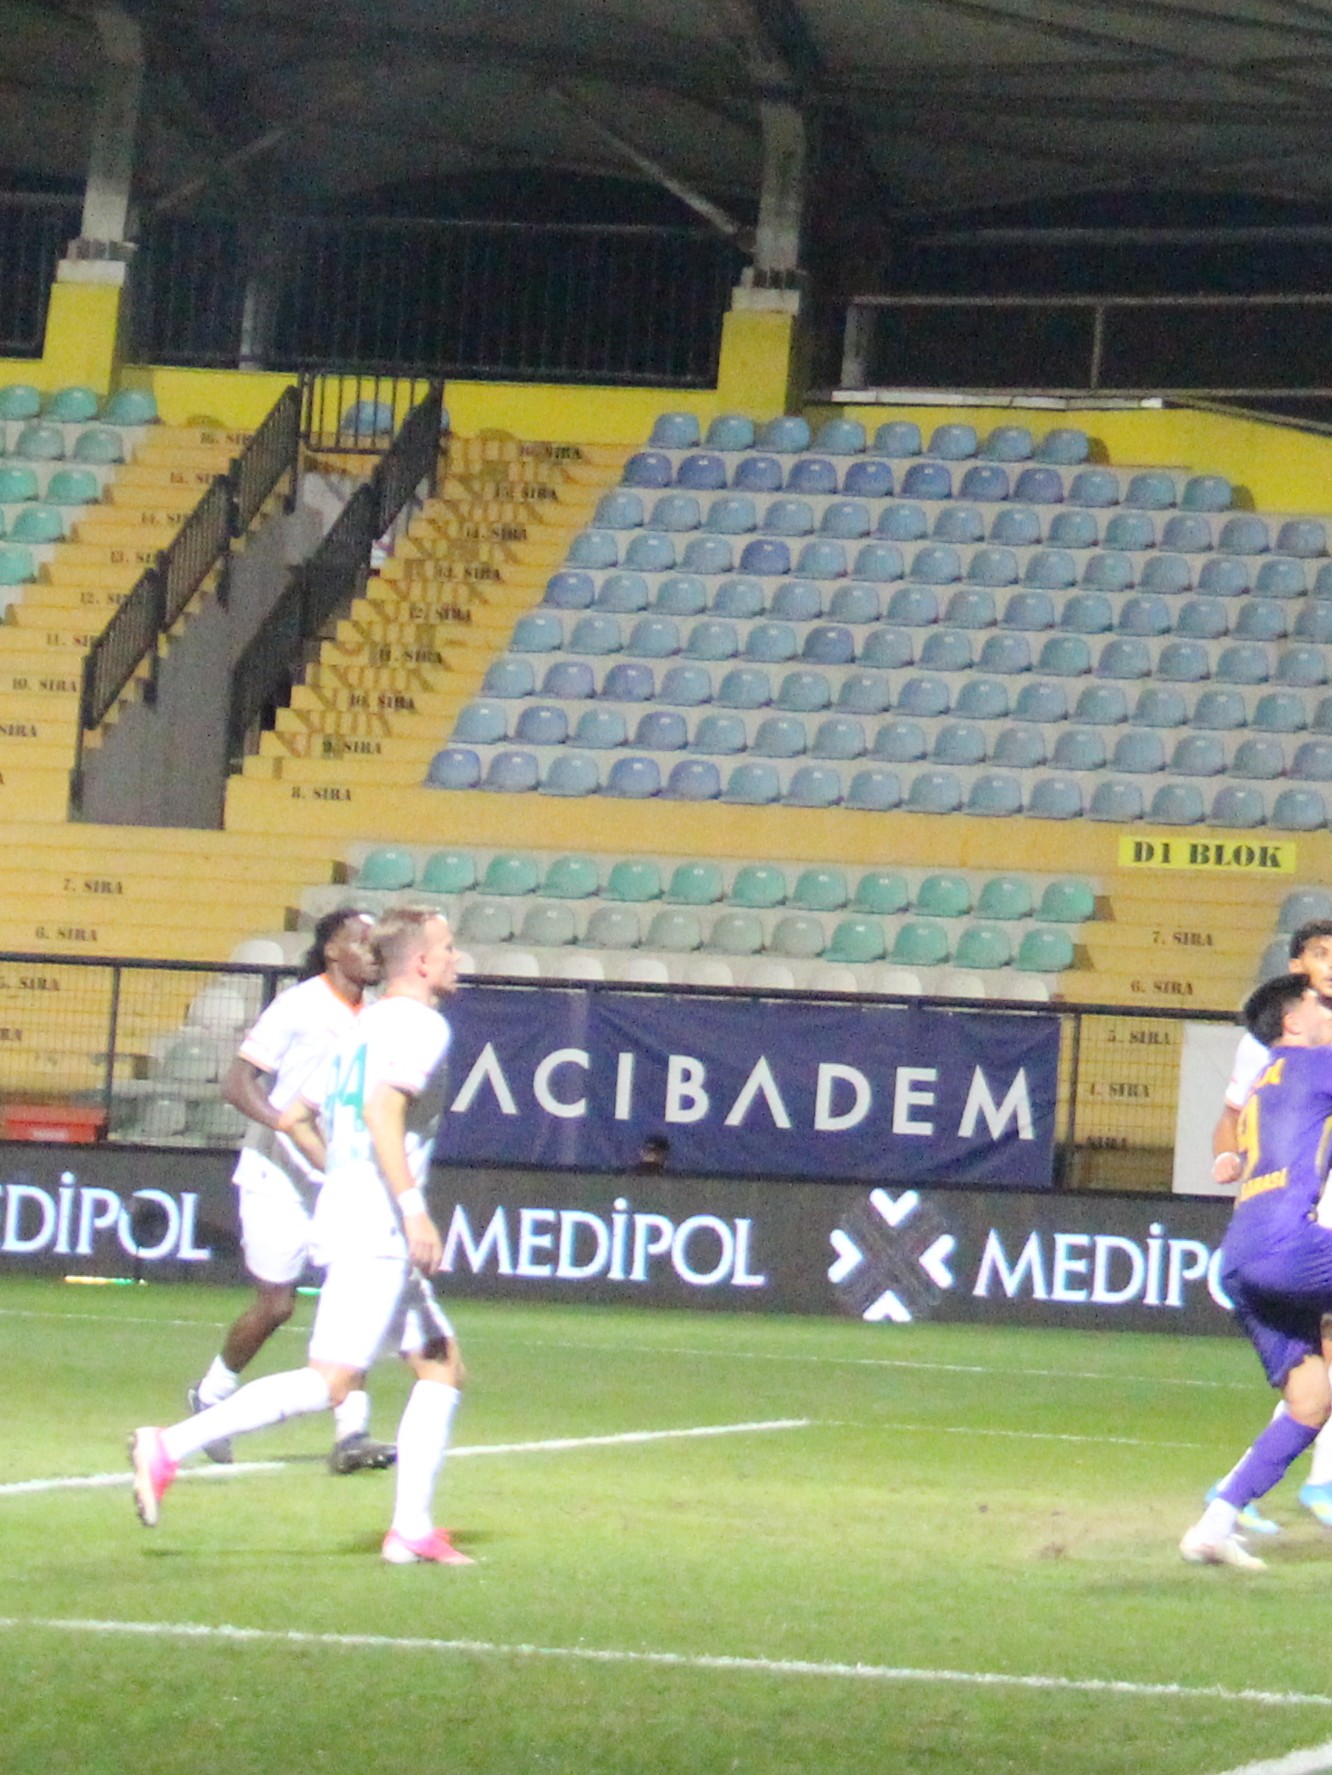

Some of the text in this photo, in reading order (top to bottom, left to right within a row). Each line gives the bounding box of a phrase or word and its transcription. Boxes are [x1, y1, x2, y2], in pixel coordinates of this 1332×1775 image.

[521, 486, 558, 500] SIRA
[464, 567, 501, 581] SIRA
[436, 607, 472, 623] SIRA
[404, 650, 443, 665] SIRA
[40, 678, 77, 693] SIRA
[376, 694, 415, 709] SIRA
[343, 741, 382, 754] SIRA
[313, 787, 352, 801] SIRA
[1132, 840, 1283, 869] D1 BLOK
[63, 878, 124, 895] 7. SIRA
[57, 928, 98, 942] SIRA
[1152, 930, 1214, 947] 7. SIRA
[19, 976, 61, 992] SIRA
[1130, 979, 1195, 996] 6. SIRA
[1128, 1030, 1173, 1046] SIRA
[450, 1041, 1037, 1142] ACIBADEM
[1109, 1082, 1151, 1098] SIRA
[0, 1171, 212, 1261] DİPOL
